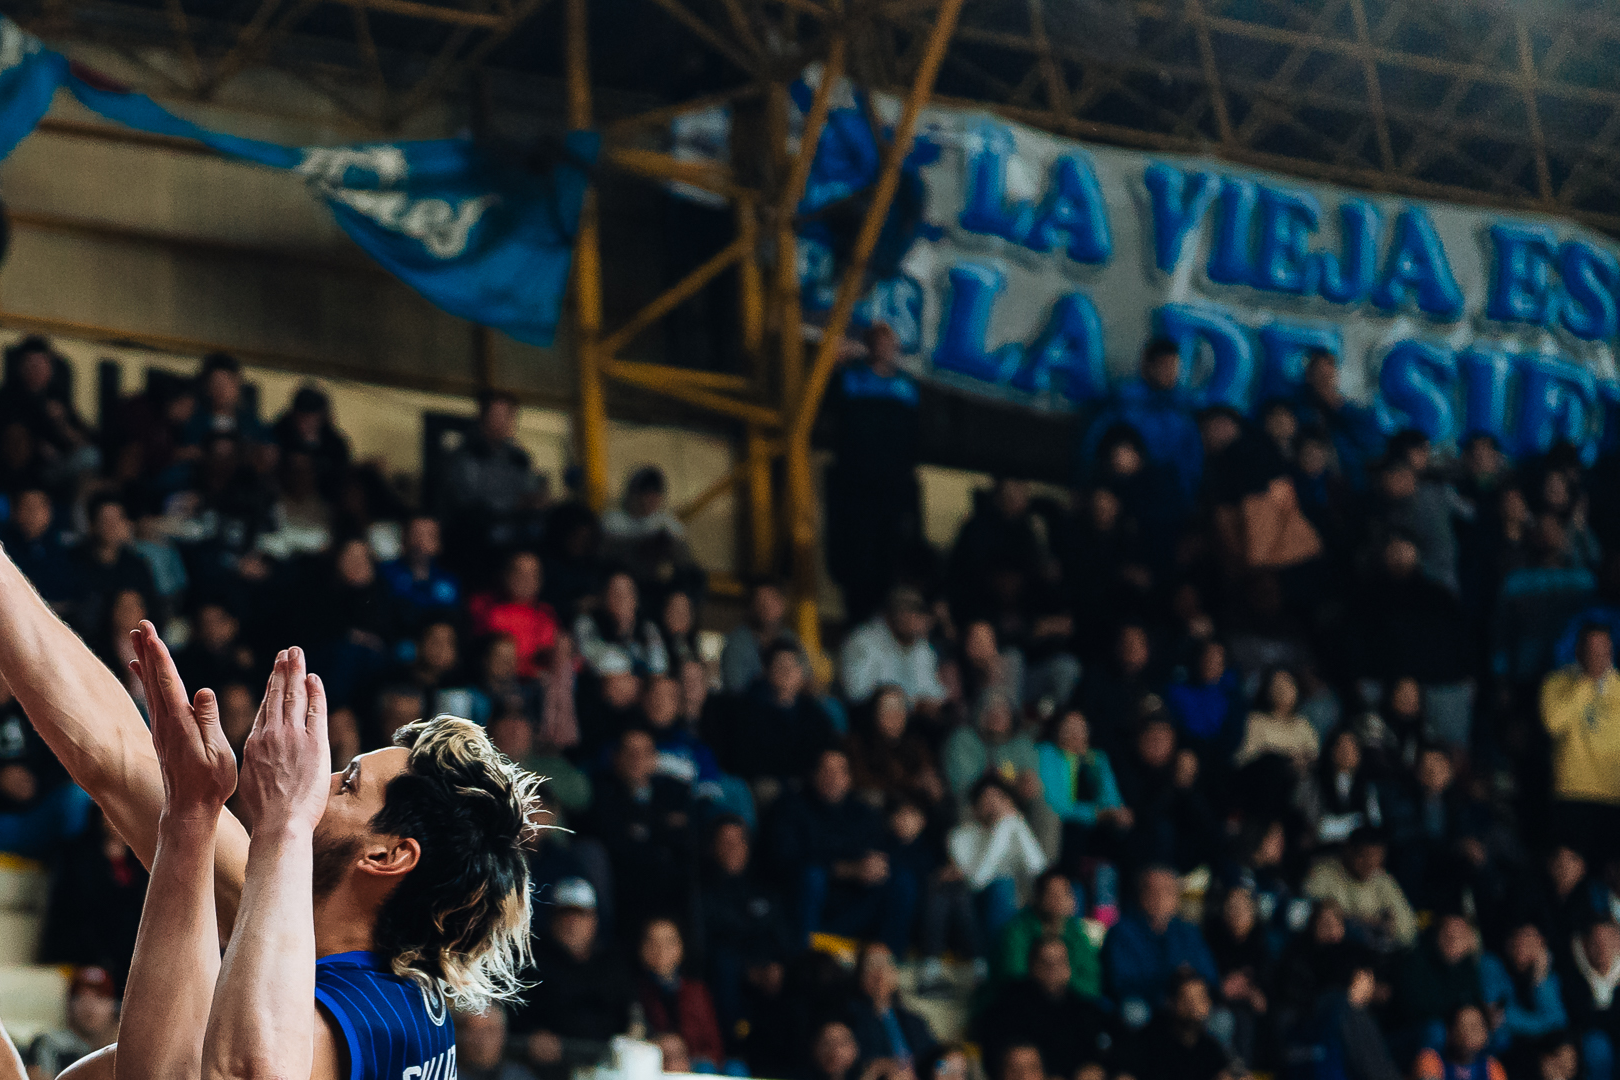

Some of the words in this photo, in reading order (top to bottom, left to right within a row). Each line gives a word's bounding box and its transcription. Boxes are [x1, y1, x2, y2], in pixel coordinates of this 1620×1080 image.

[957, 120, 1114, 266] LA
[1144, 160, 1465, 320] VIEJA
[1486, 222, 1620, 342] ES
[932, 260, 1110, 404] LA
